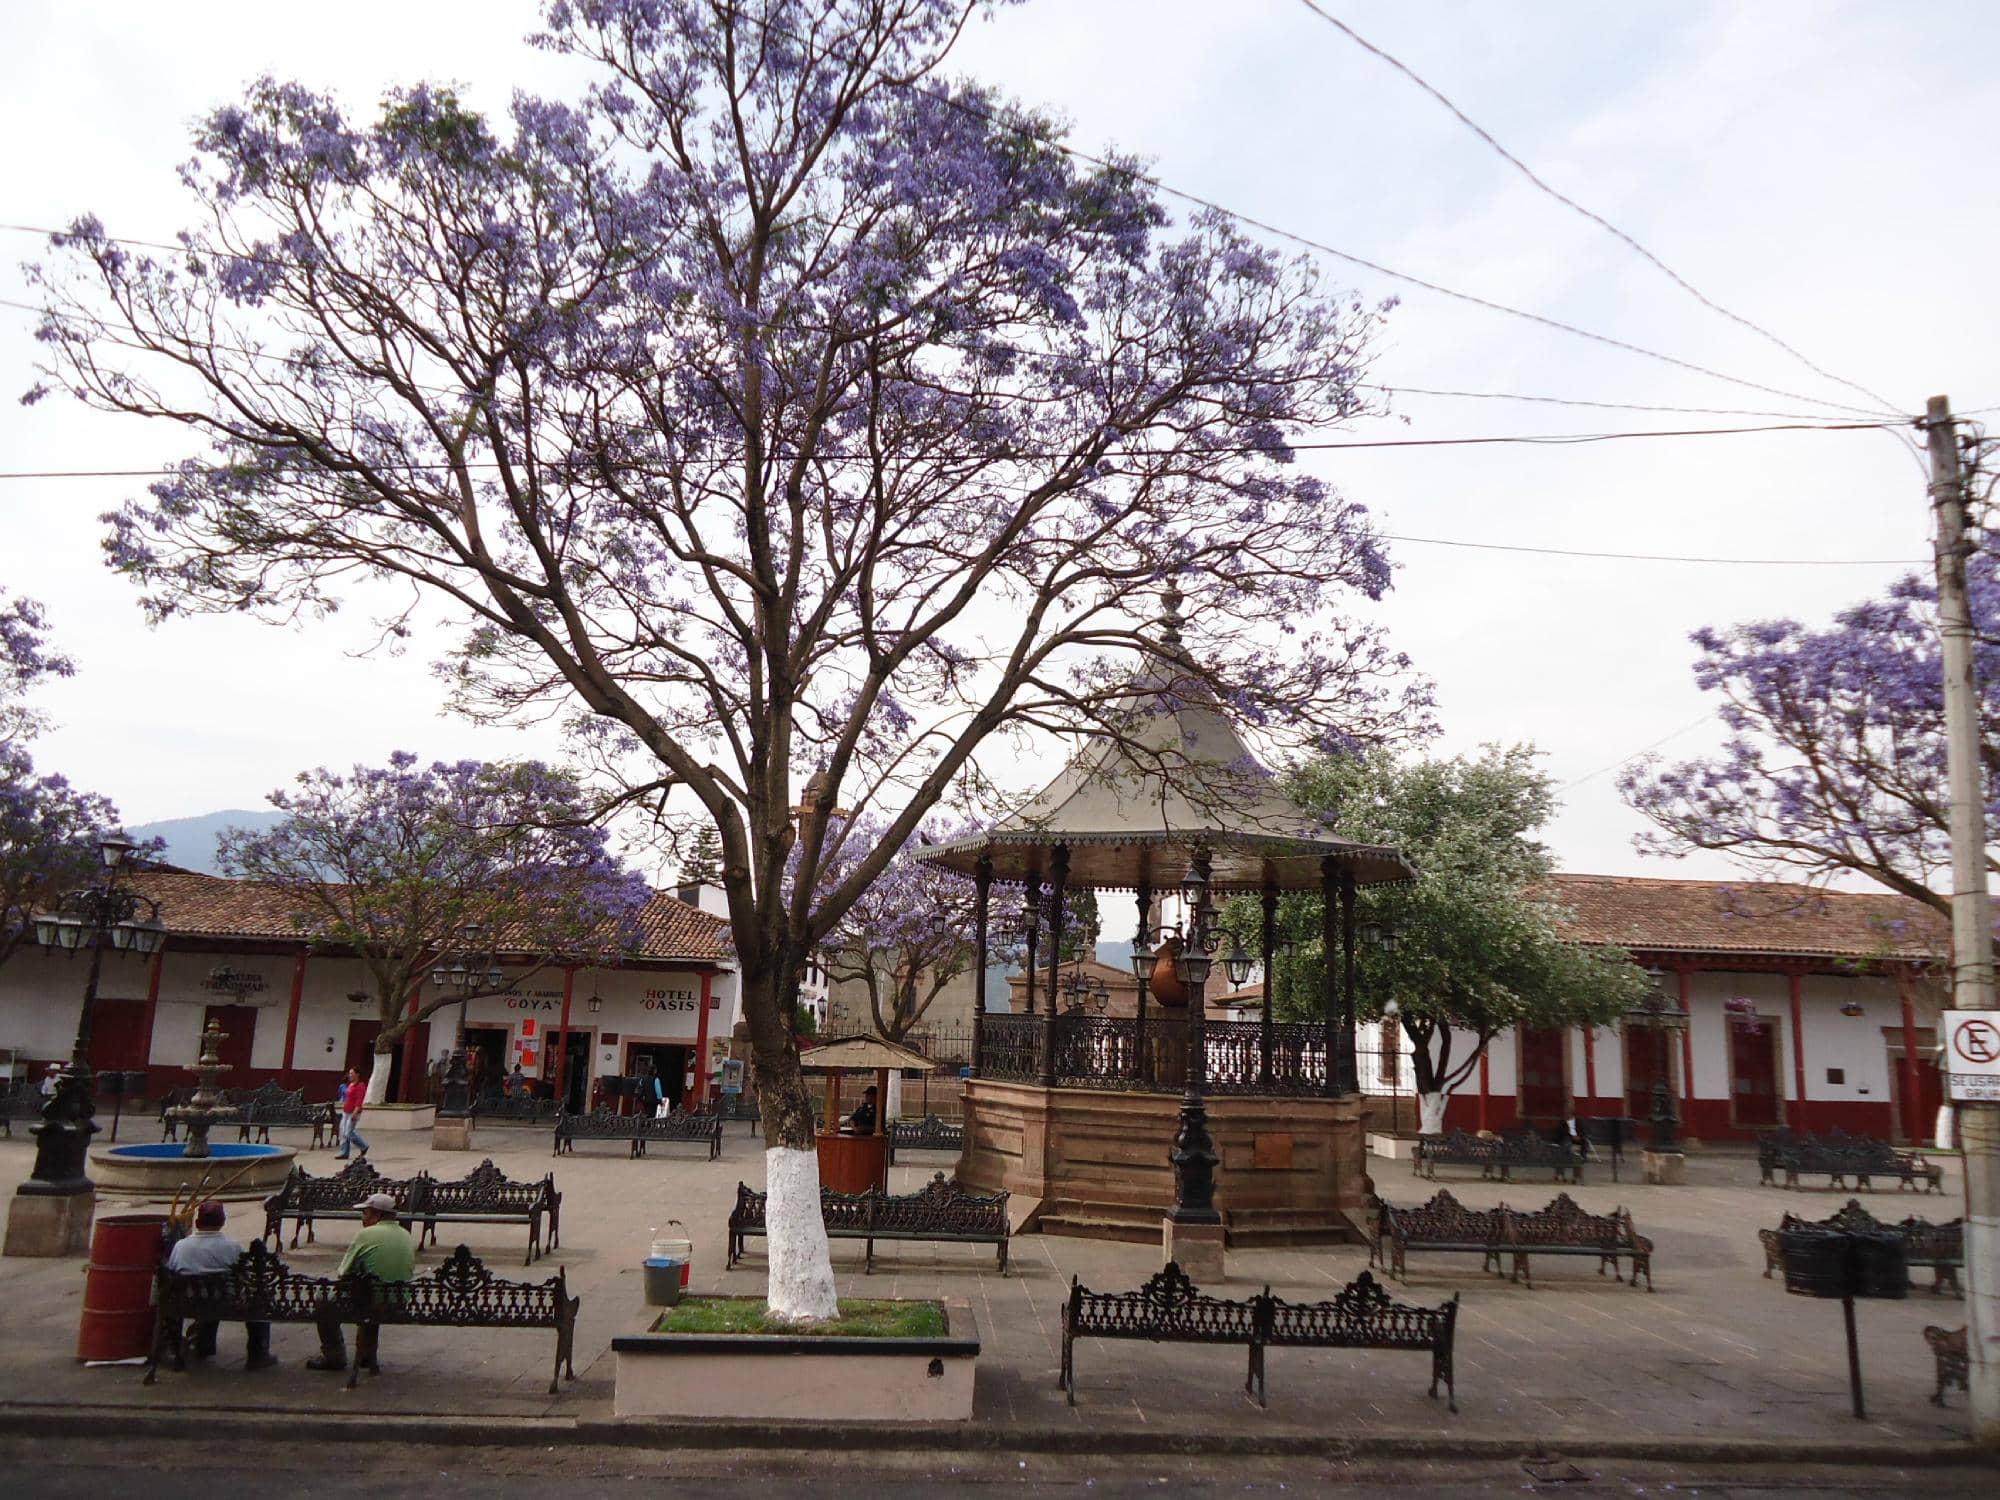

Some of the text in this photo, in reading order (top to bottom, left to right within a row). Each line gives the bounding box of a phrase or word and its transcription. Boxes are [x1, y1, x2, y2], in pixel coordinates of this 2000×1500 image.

[646, 989, 696, 1000] HOTEL
[504, 998, 560, 1010] "GOYA"
[640, 999, 700, 1011] "OASIS"
[1952, 1075, 1966, 1087] SE
